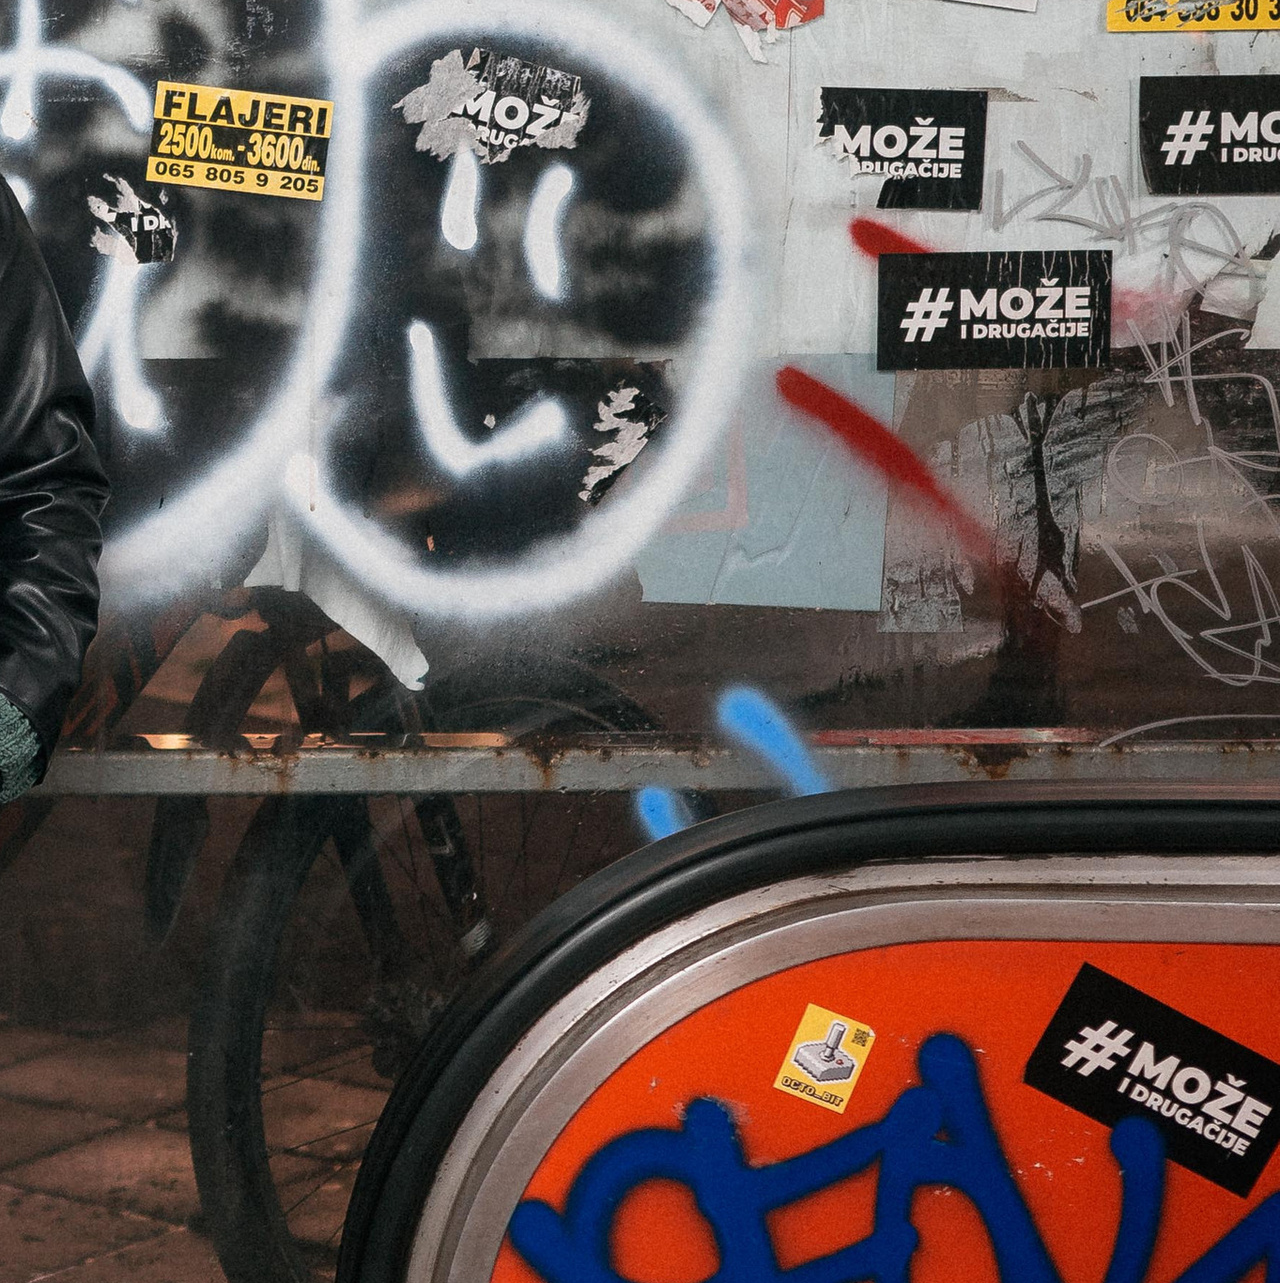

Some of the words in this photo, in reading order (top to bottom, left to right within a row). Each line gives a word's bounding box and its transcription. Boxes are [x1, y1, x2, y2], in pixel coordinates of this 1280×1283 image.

[163, 90, 328, 136] FLAJERI
[452, 89, 580, 137] MOŽ
[834, 117, 965, 159] MOŽE
[1221, 148, 1227, 163] I
[1233, 147, 1280, 162] DRU
[155, 161, 195, 179] 065
[205, 167, 245, 185] 805
[256, 173, 268, 187] 9
[280, 176, 319, 193] 205
[961, 324, 966, 339] I
[973, 319, 1089, 339] DRUGAČIJE
[1117, 1077, 1129, 1093] I
[1130, 1084, 1251, 1156] DRUGAČIJE
